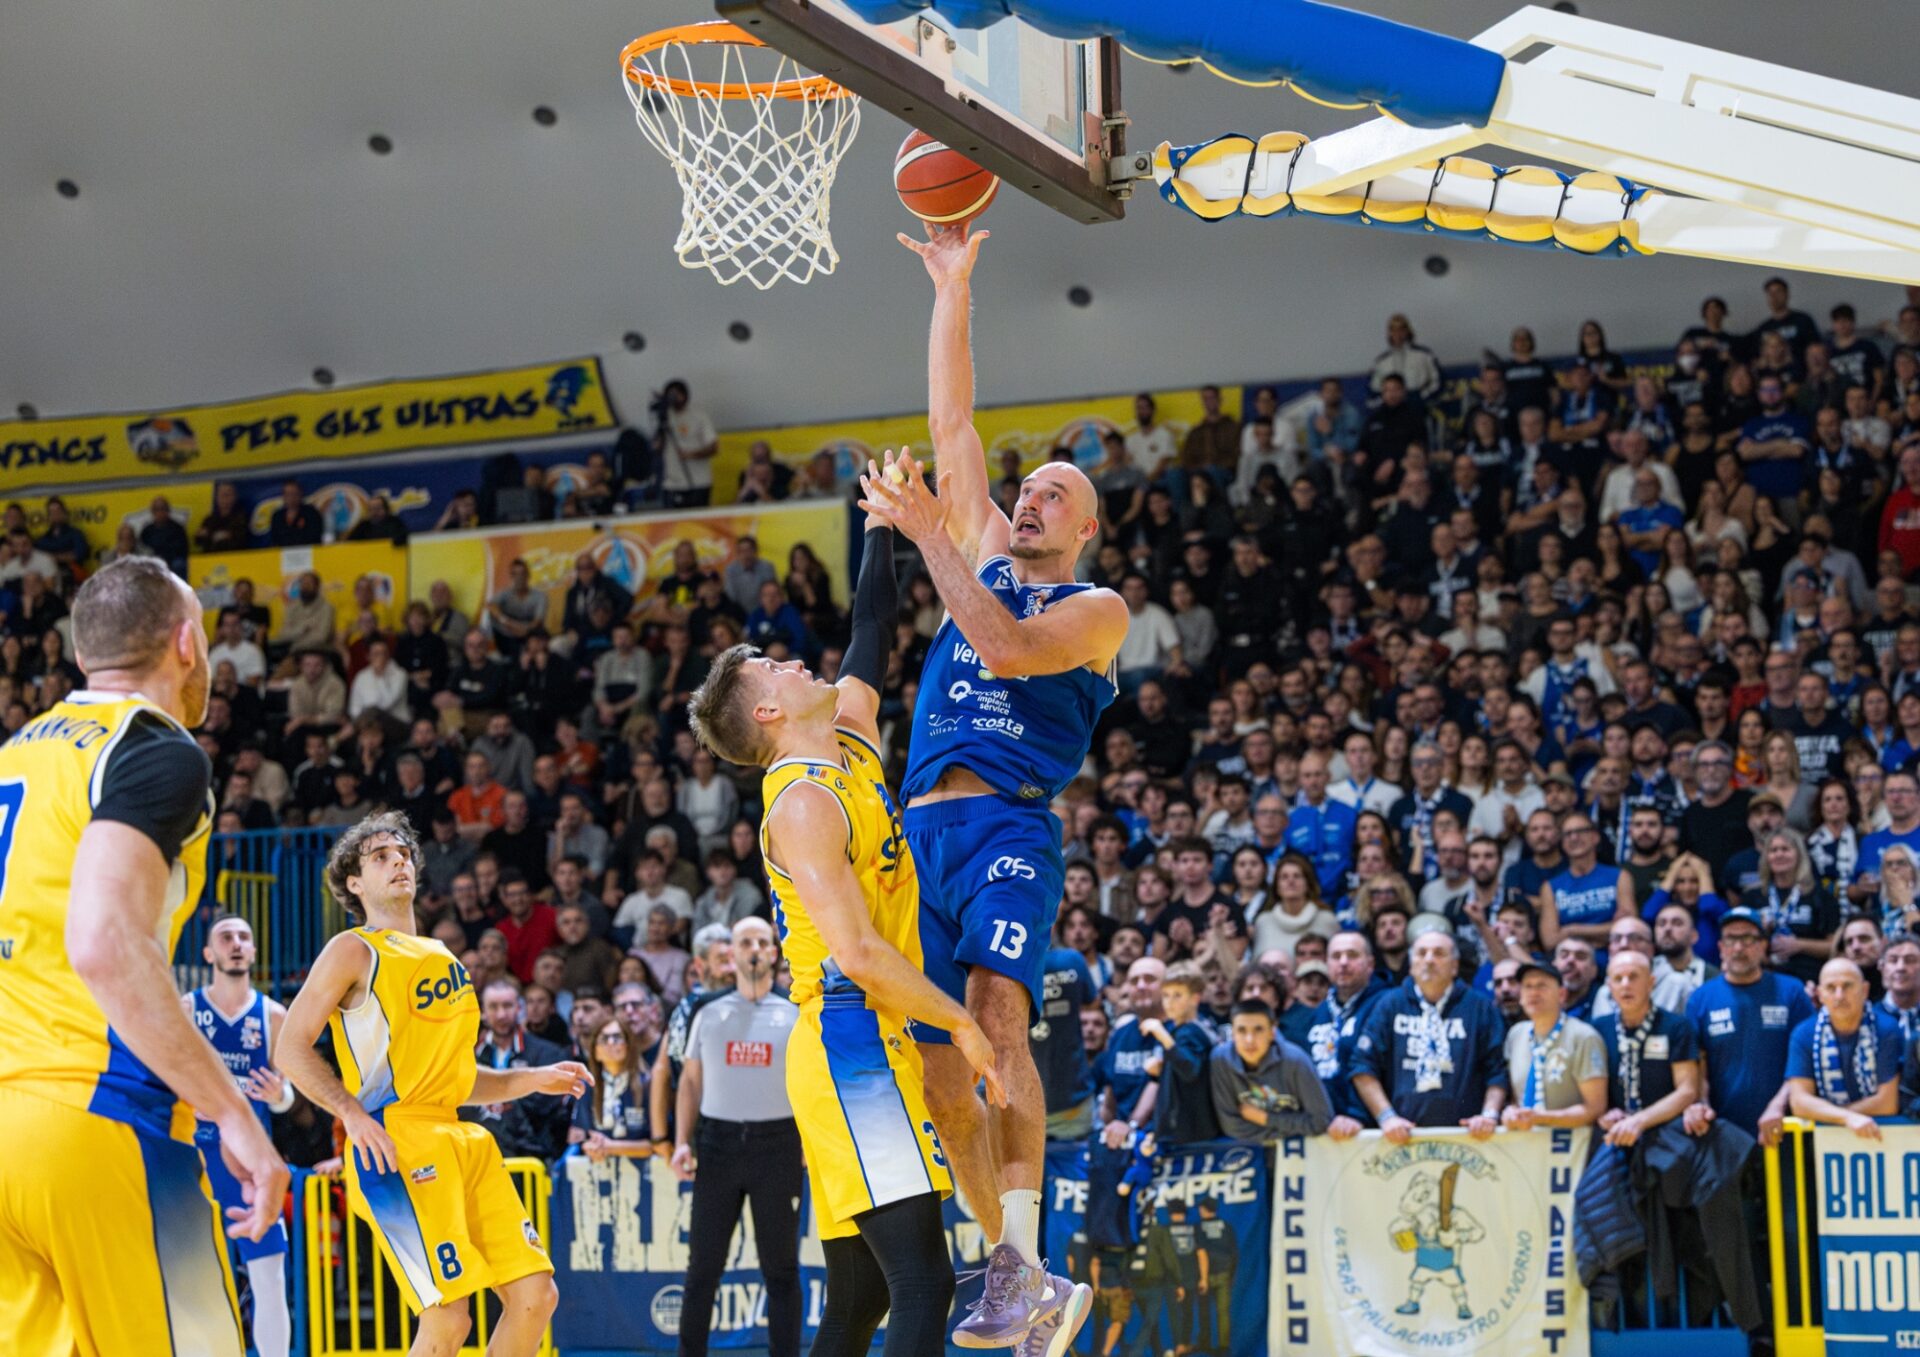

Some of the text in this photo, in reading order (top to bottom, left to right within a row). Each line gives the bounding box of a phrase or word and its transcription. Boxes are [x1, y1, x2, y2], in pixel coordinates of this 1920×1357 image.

[219, 415, 300, 453] PER
[314, 405, 383, 440] GLI
[395, 389, 540, 428] ULTRAS
[979, 702, 1010, 716] service
[989, 919, 1028, 960] 13
[195, 1010, 213, 1026] 10
[923, 1120, 948, 1169] 3
[437, 1242, 463, 1281] 8
[1500, 1230, 1533, 1310] LIVORNO
